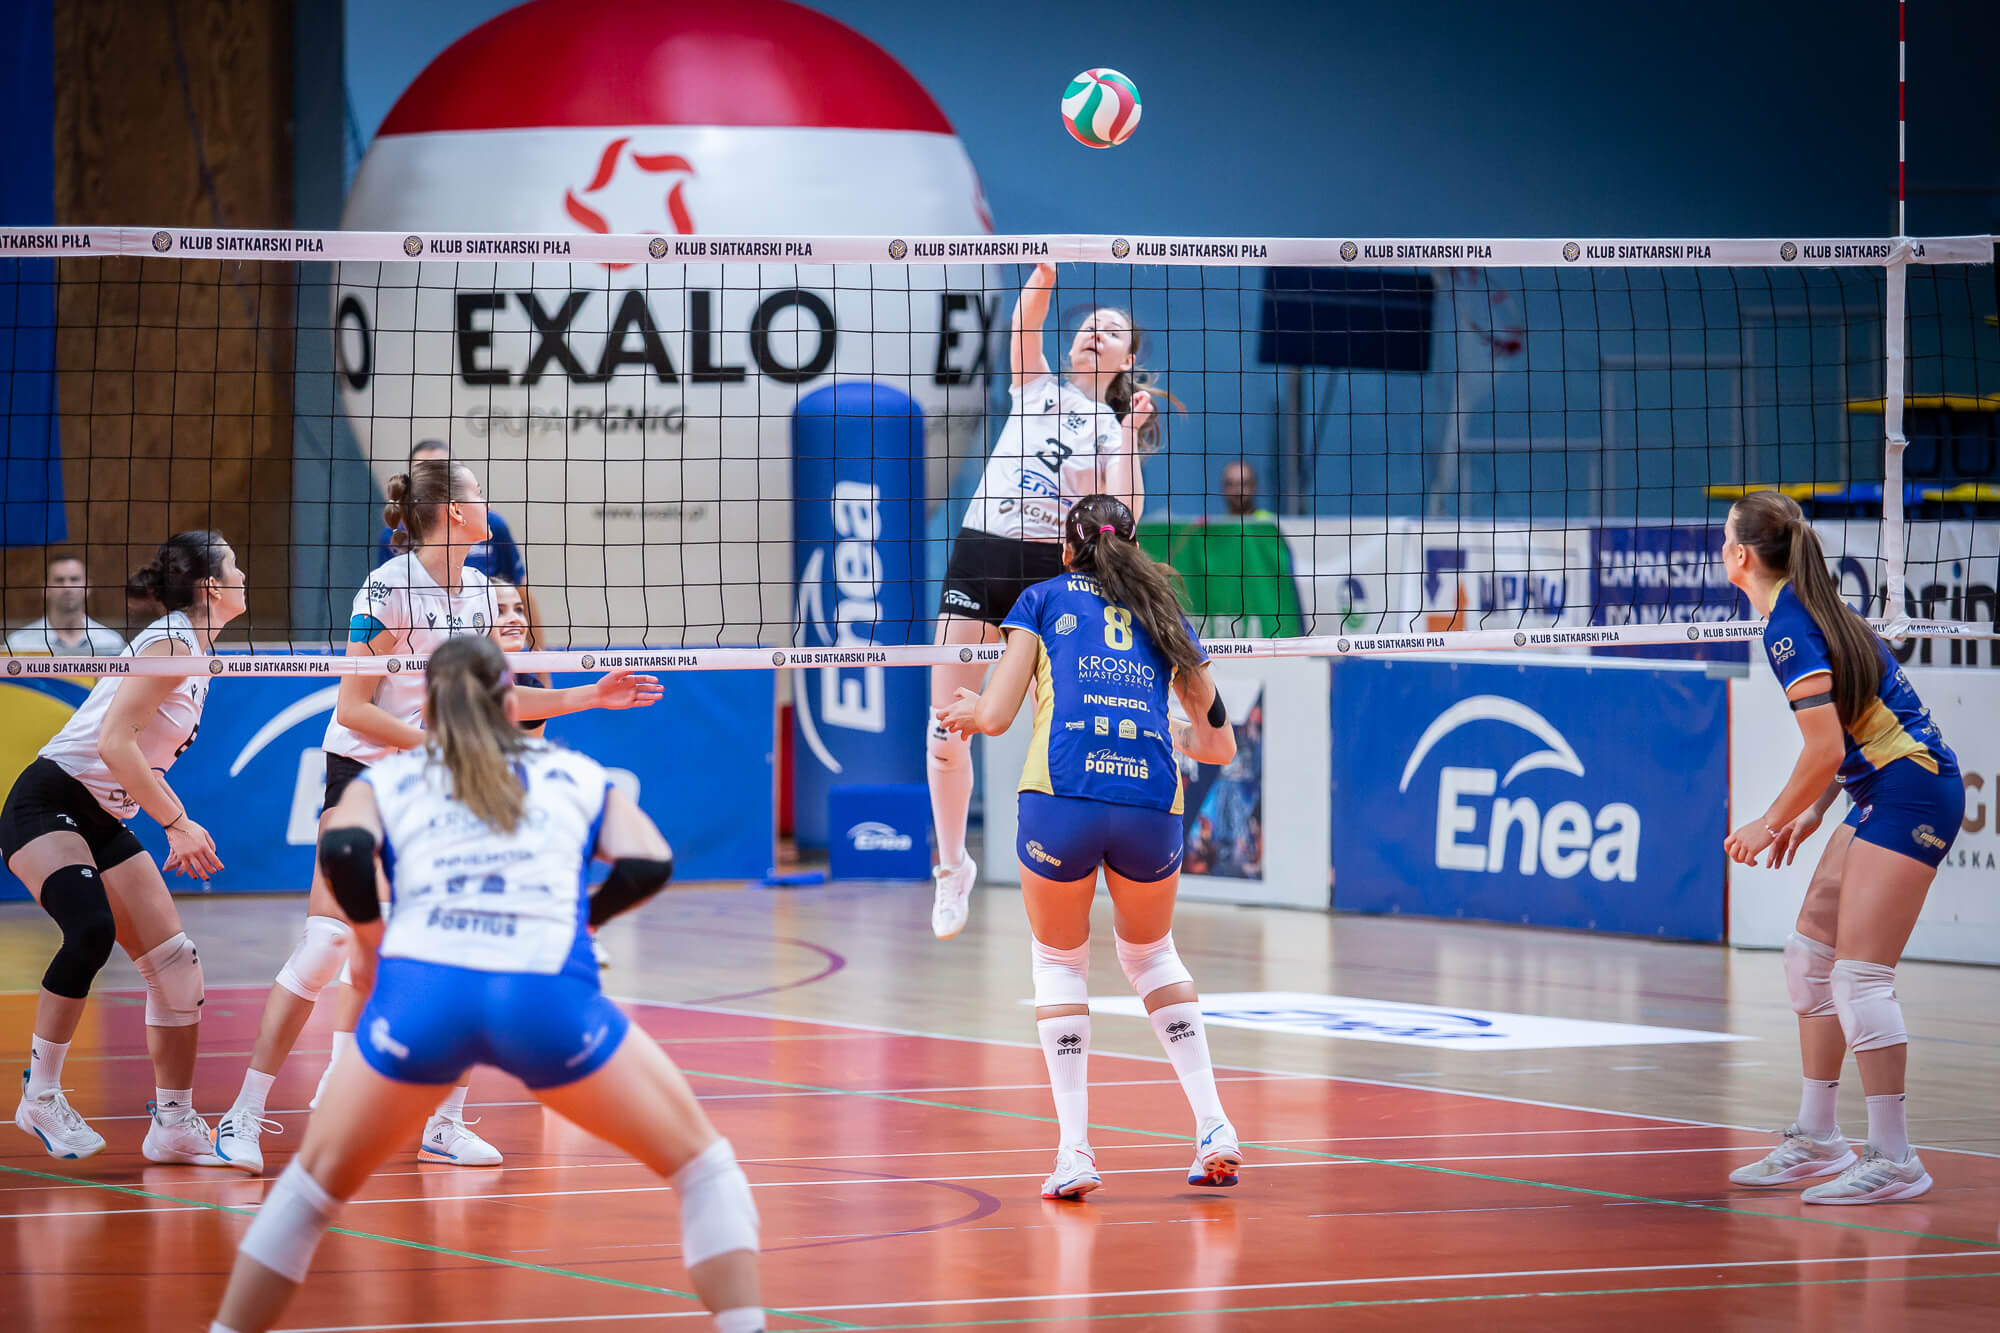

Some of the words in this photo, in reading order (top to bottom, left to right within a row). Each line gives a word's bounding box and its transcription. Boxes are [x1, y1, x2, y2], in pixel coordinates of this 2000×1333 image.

[0, 234, 58, 249] TKARSKI
[61, 233, 92, 249] PIŁA
[179, 235, 213, 250] KLUB
[216, 236, 292, 252] SIATKARSKI
[295, 237, 324, 253] PIŁA
[430, 239, 463, 253] KLUB
[466, 240, 540, 254] SIATKARSKI
[543, 240, 571, 255] PIŁA
[675, 241, 707, 256] KLUB
[709, 242, 782, 256] SIATKARSKI
[785, 242, 813, 256] PIŁA
[914, 243, 945, 257] KLUB
[948, 242, 1019, 257] SIATKARSKI
[1022, 241, 1049, 256] PIŁA
[1136, 242, 1167, 257] KLUB
[1169, 243, 1238, 258] SIATKARSKI
[1241, 243, 1268, 258] PIŁA
[1364, 245, 1394, 259] KLUB
[1396, 245, 1464, 259] SIATKARSKI
[1466, 245, 1492, 259] PIŁA
[1586, 245, 1615, 259] KLUB
[1618, 245, 1684, 259] SIATKARSKI
[1686, 245, 1712, 259] PIŁA
[1803, 245, 1832, 259] KLUB
[1834, 245, 1890, 259] SIATKARS
[456, 288, 836, 386] EXALO
[1036, 437, 1073, 473] 3
[821, 480, 886, 733] Enea
[1103, 605, 1133, 651] 8
[1703, 628, 1724, 638] KLUB
[1725, 626, 1766, 637] SIATKARS
[1354, 640, 1376, 650] KLUB
[1377, 639, 1425, 649] SIATKARSKI
[1426, 637, 1445, 648] PIŁA
[1530, 634, 1551, 644] KLUB
[1553, 633, 1599, 643] SIATKARSKI
[1600, 631, 1620, 642] PIŁA
[977, 650, 999, 660] KLUB
[1203, 644, 1233, 655] KARSKI
[1234, 643, 1253, 654] PIŁA
[600, 657, 623, 667] KLUB
[624, 656, 676, 667] SIATKARSKI
[678, 656, 698, 666] PIŁA
[790, 653, 813, 664] KLUB
[814, 652, 865, 664] SIATKARSKI
[867, 651, 887, 662] PIŁA
[26, 663, 51, 673] KLUB
[53, 663, 107, 673] SIATKARSKI
[109, 662, 130, 673] PIŁA
[228, 662, 252, 672] KLUB
[254, 662, 307, 672] SIATKARSKI
[309, 662, 330, 672] PIŁA
[1078, 655, 1155, 681] KROSNO
[1078, 670, 1122, 682] MIASTO
[1124, 674, 1154, 689] SZKŁA
[1085, 759, 1149, 780] PORTIUS
[1436, 766, 1641, 883] Enea
[854, 834, 913, 851] Enea
[1946, 849, 1996, 869] LSKA
